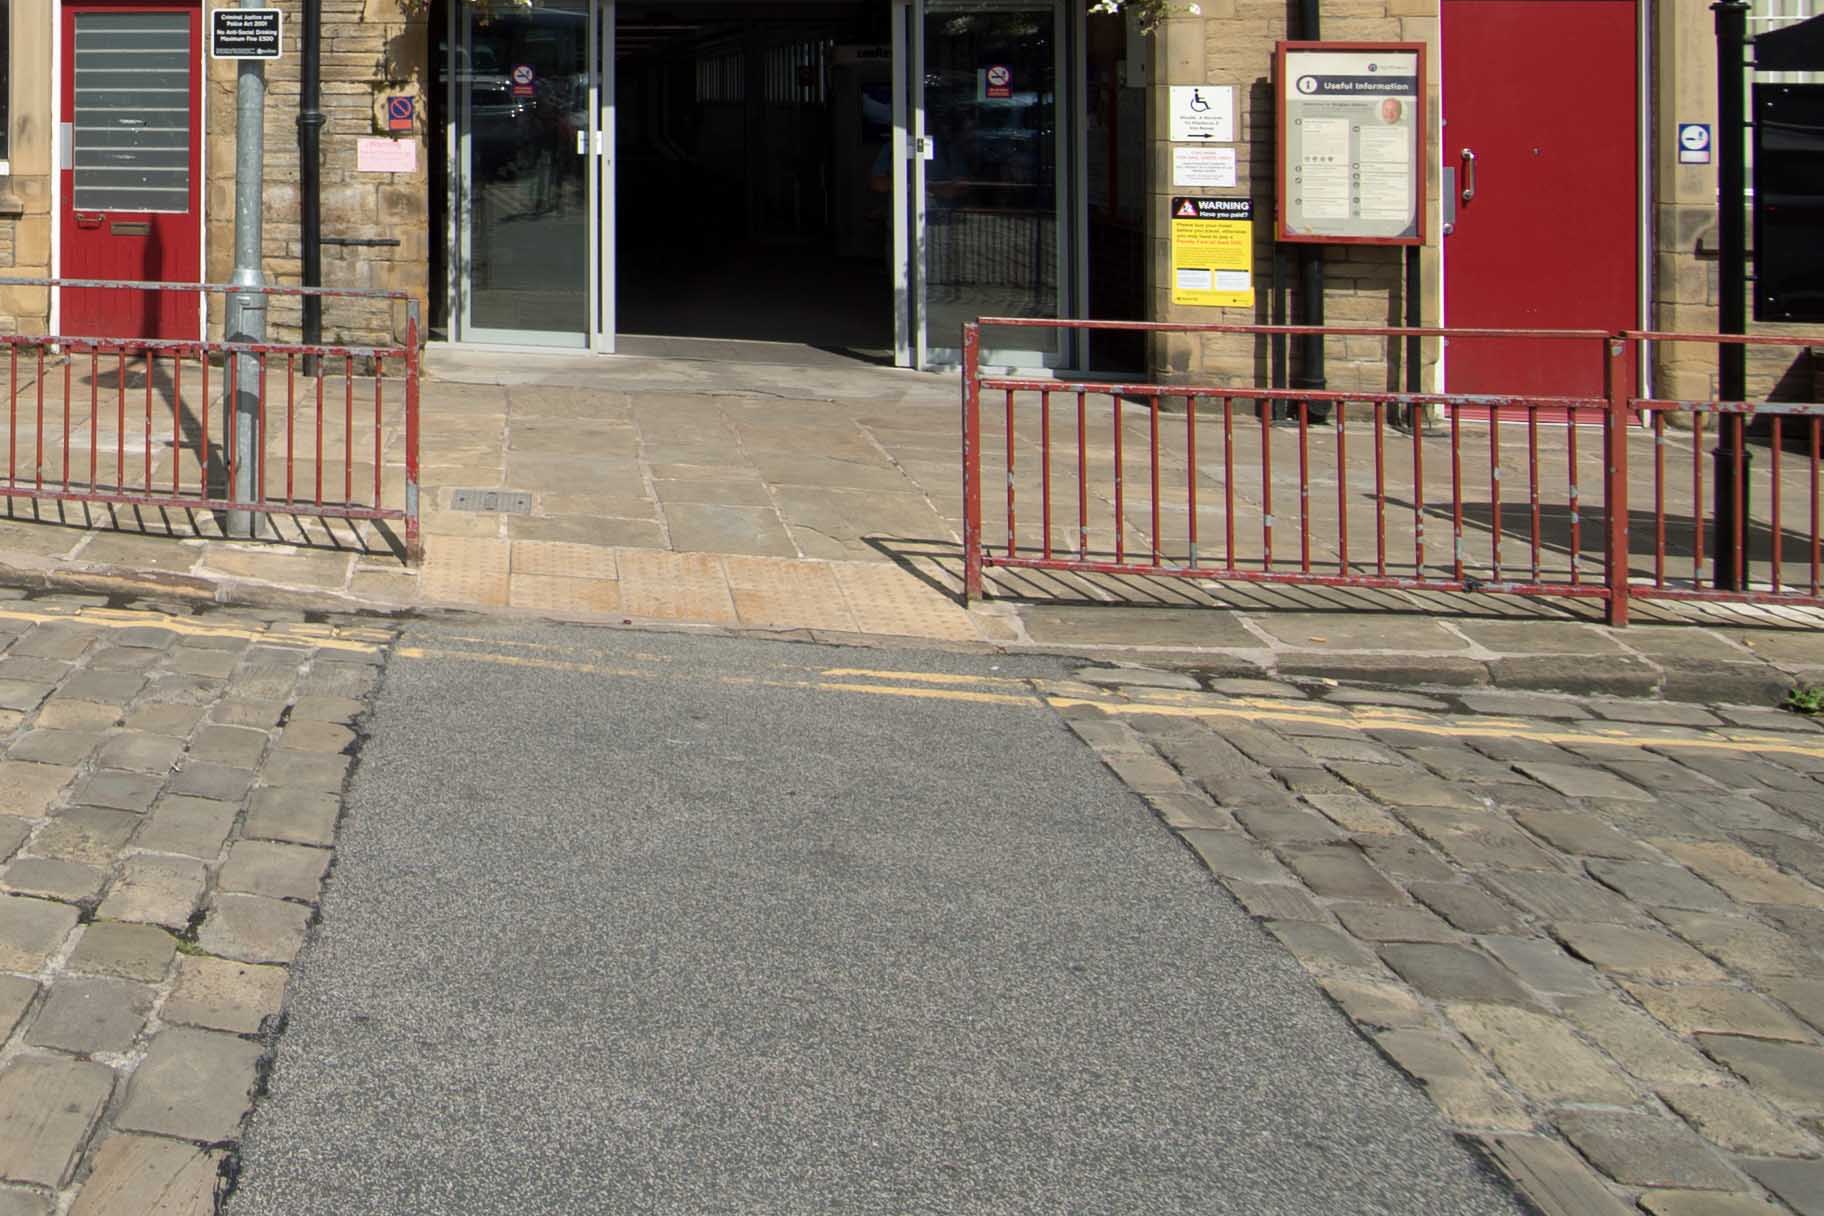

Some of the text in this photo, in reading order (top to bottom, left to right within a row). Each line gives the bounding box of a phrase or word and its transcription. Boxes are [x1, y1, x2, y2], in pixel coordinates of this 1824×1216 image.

[1324, 82, 1409, 90] Useful Information
[1198, 201, 1249, 210] WARNING
